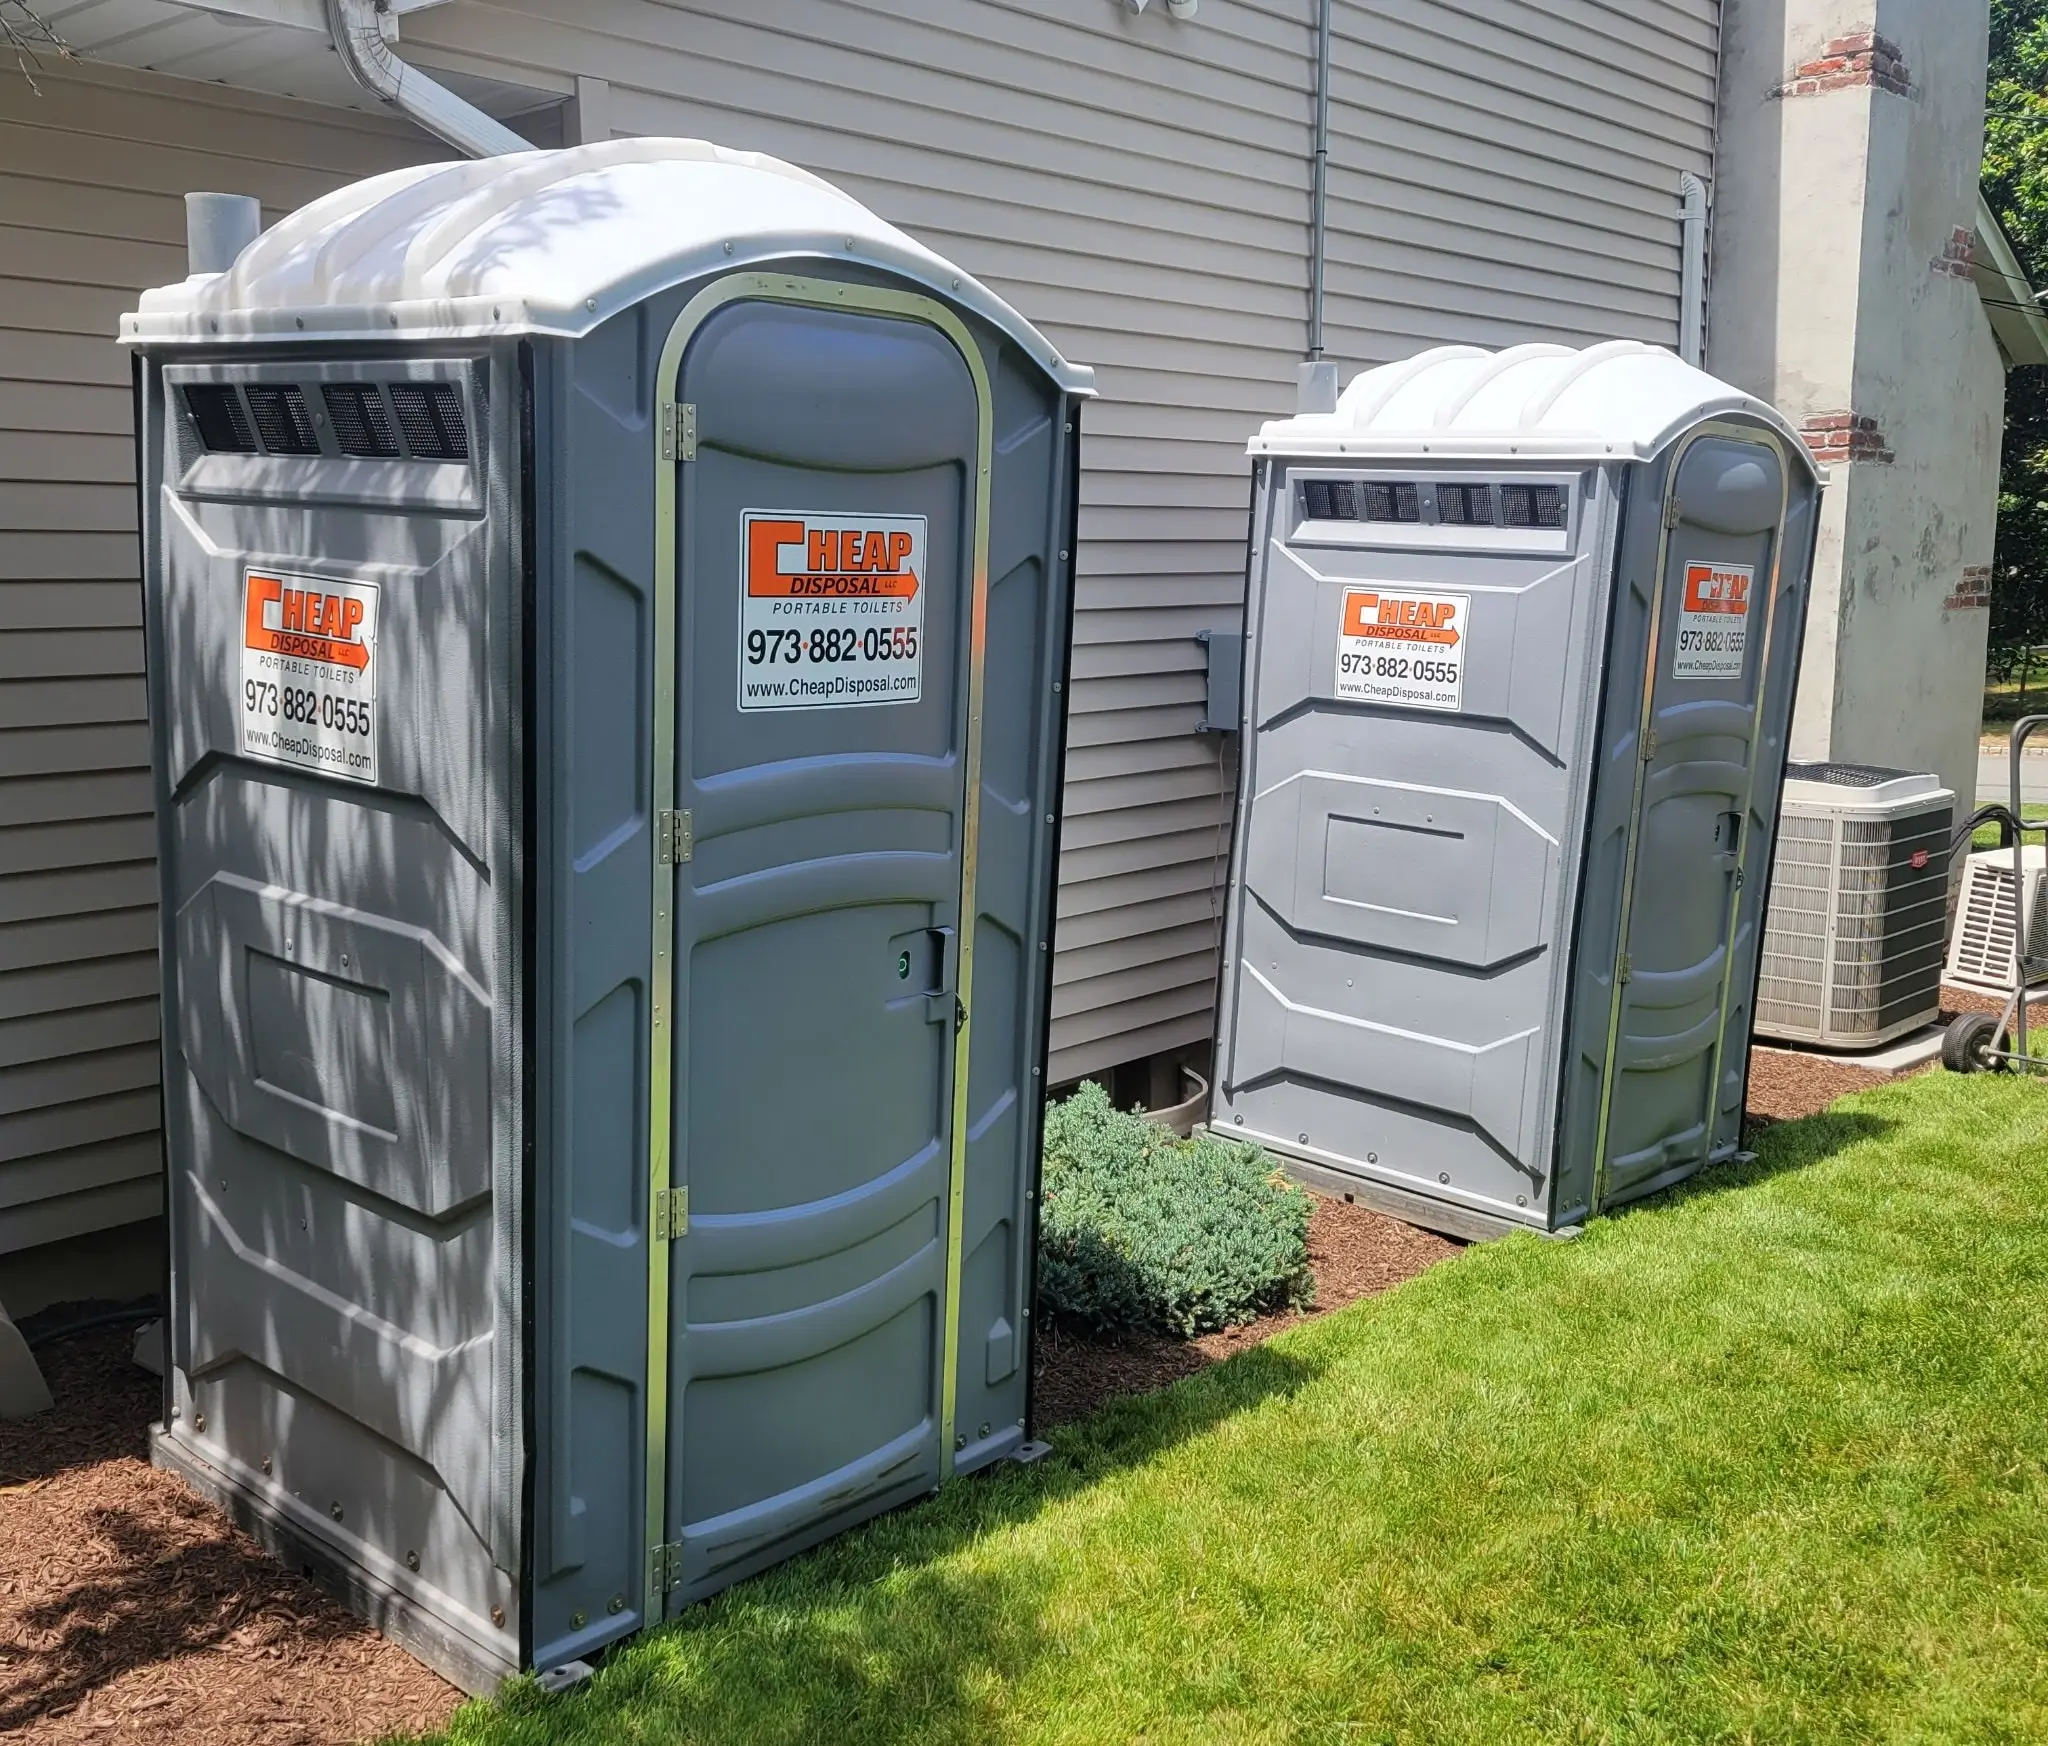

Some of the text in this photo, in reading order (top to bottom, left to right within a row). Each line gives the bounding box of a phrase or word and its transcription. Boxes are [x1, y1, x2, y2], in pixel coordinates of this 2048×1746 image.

[748, 519, 912, 596] CHEAP
[790, 577, 897, 594] DISPOSAL LLC
[246, 576, 364, 646] CHEAP
[772, 601, 903, 614] PORTABLE TOILETS
[1343, 592, 1455, 634] CHEAP
[1366, 626, 1428, 640] DISPOSAL
[270, 633, 350, 660] DISPOSAL LLC
[1355, 639, 1445, 653] PORTABLE TOILETS
[259, 655, 355, 684] PORTABLE TOILETS
[747, 675, 917, 698] www.CheapDisposal.com
[1340, 682, 1456, 703] www.CheapDisposal.com
[246, 728, 372, 769] www.CheapDisposal.com
